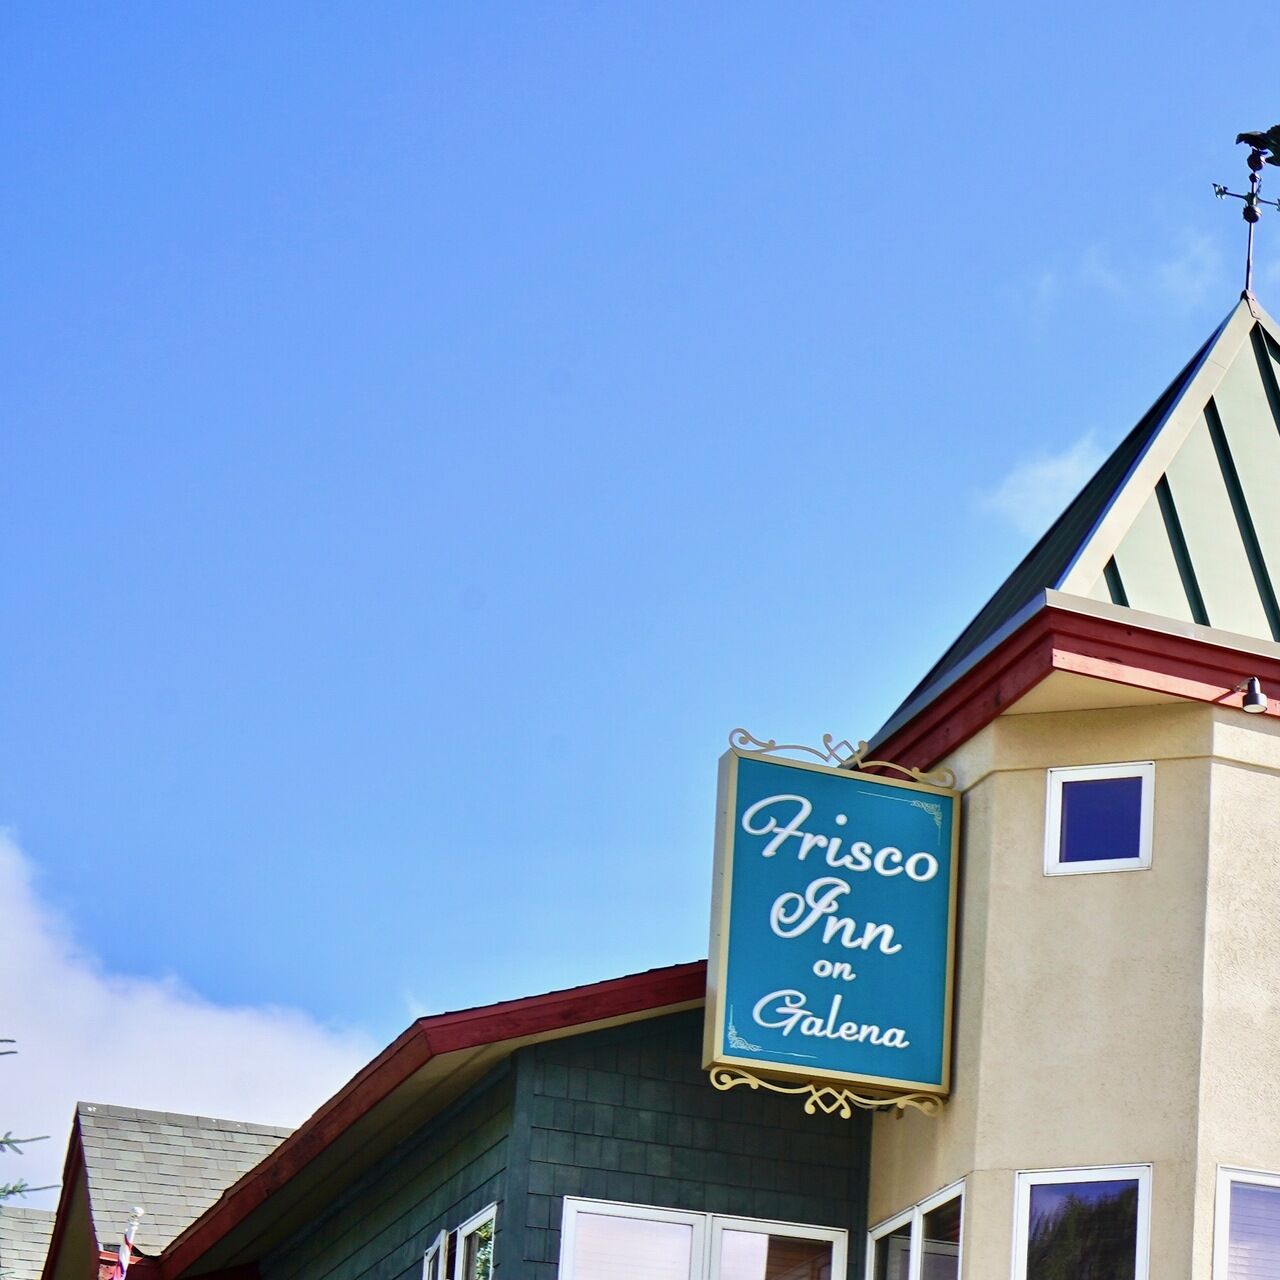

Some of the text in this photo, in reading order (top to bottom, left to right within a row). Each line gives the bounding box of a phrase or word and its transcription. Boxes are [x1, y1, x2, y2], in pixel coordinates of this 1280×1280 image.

[741, 794, 939, 881] Frisco
[770, 877, 902, 954] Inn
[813, 959, 856, 981] on
[752, 989, 910, 1049] Galena
